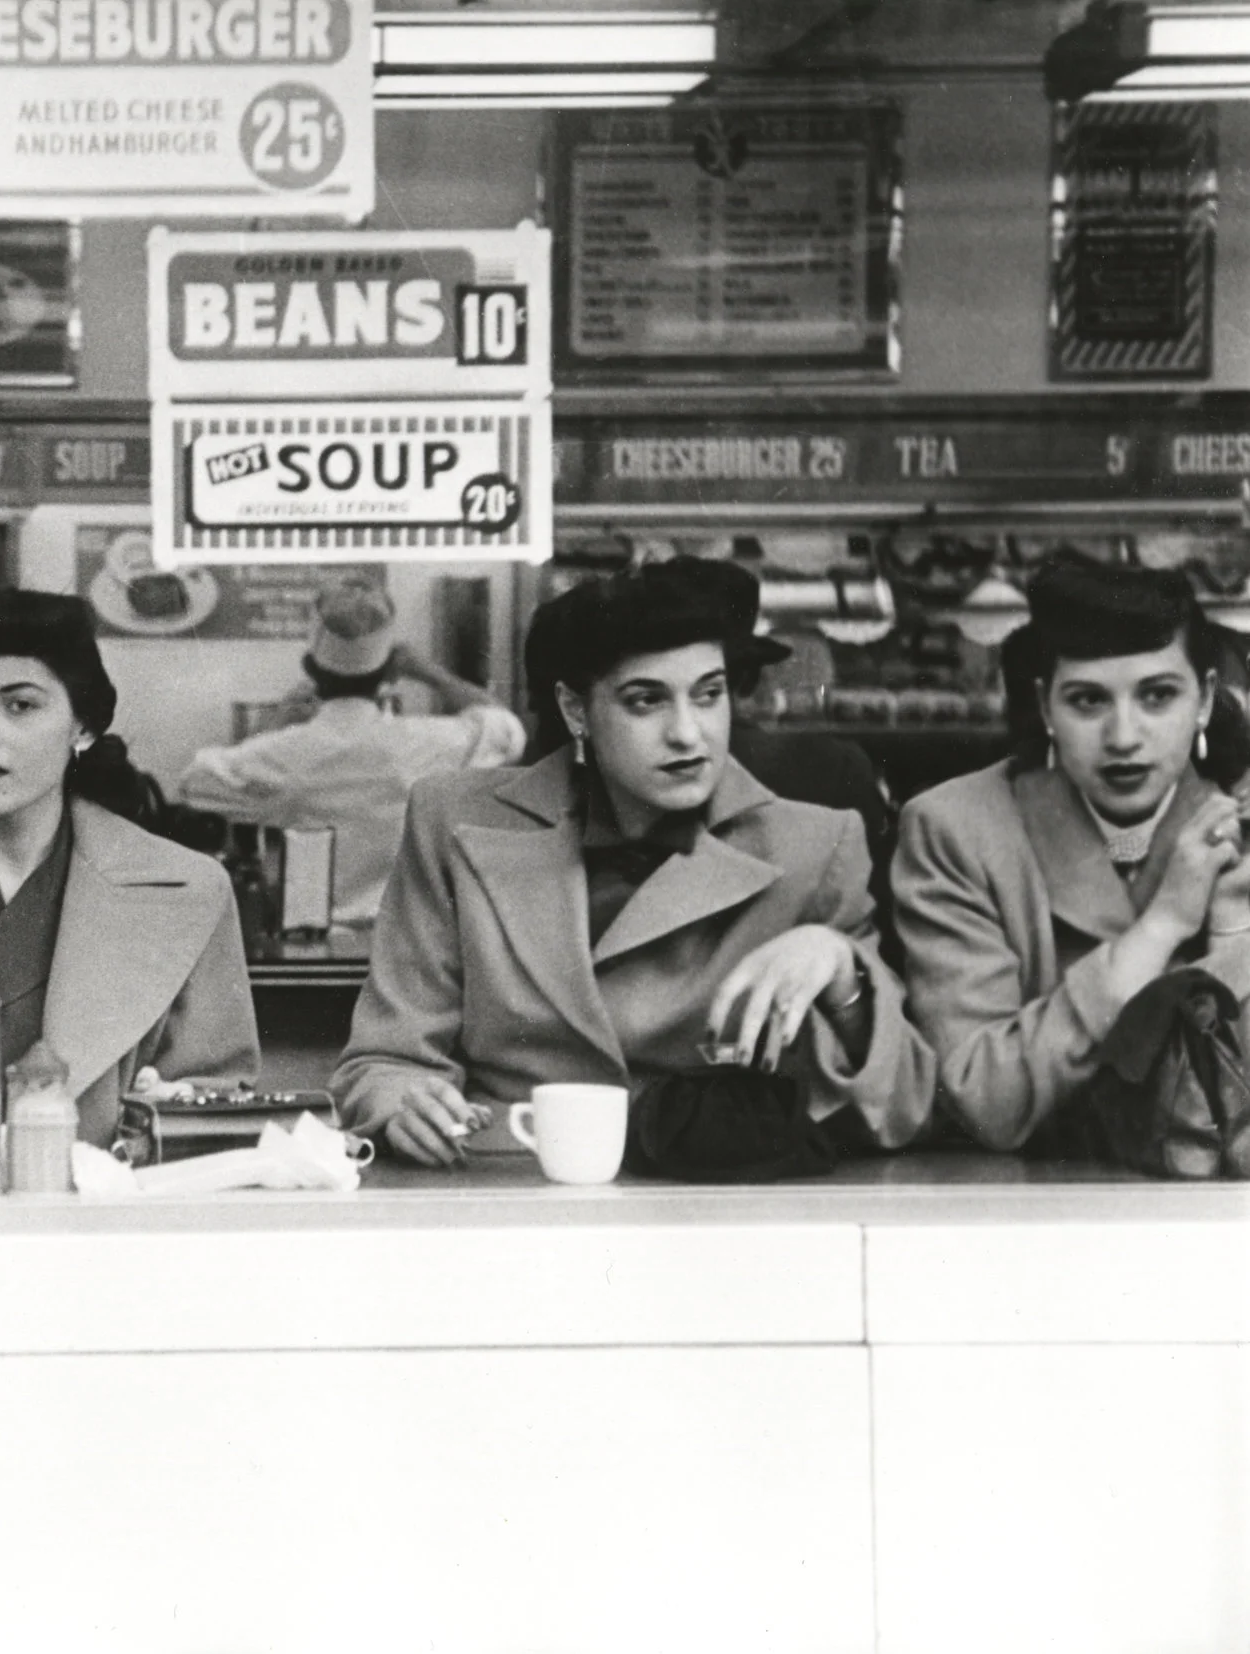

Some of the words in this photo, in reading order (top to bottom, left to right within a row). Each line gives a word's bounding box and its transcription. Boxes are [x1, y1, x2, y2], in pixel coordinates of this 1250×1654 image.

[18, 99, 118, 123] MELTED
[127, 98, 224, 122] CHEESE
[183, 279, 446, 349] BEANS
[55, 440, 126, 482] SOUP
[208, 445, 267, 483] HOT
[276, 441, 460, 492] SOUP
[613, 437, 800, 479] CHEESEBURGER
[894, 435, 959, 477] TEA
